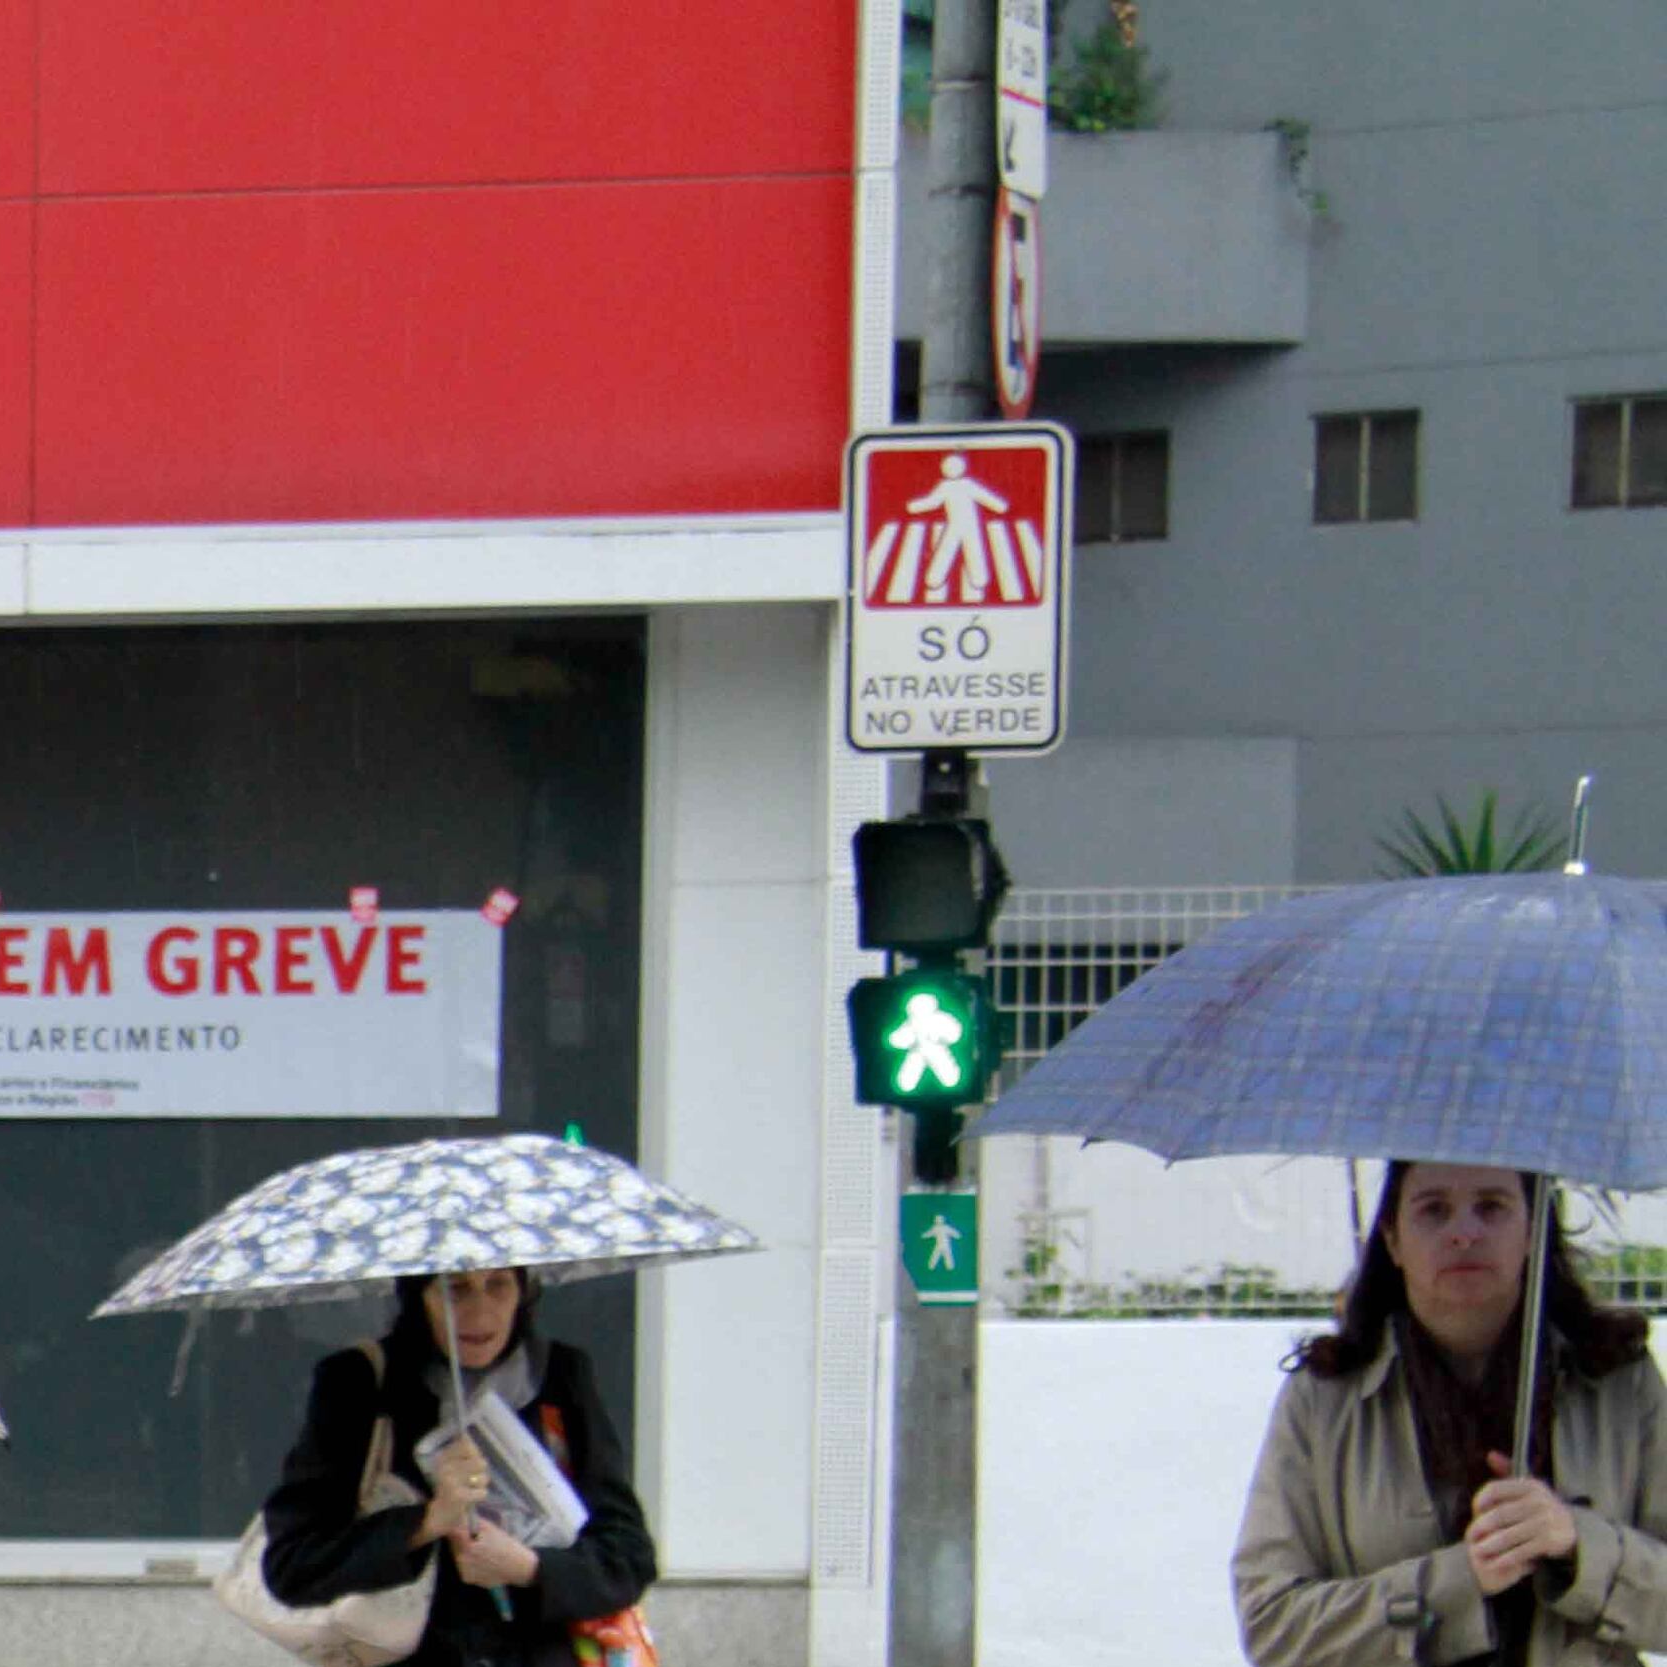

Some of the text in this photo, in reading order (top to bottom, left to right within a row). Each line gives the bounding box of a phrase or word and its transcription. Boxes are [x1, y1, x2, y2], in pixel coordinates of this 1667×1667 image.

[919, 615, 990, 662] SÓ
[861, 672, 1046, 699] ATRAVESSE
[865, 707, 1042, 736] NO VERDE
[144, 924, 428, 996] GREVE
